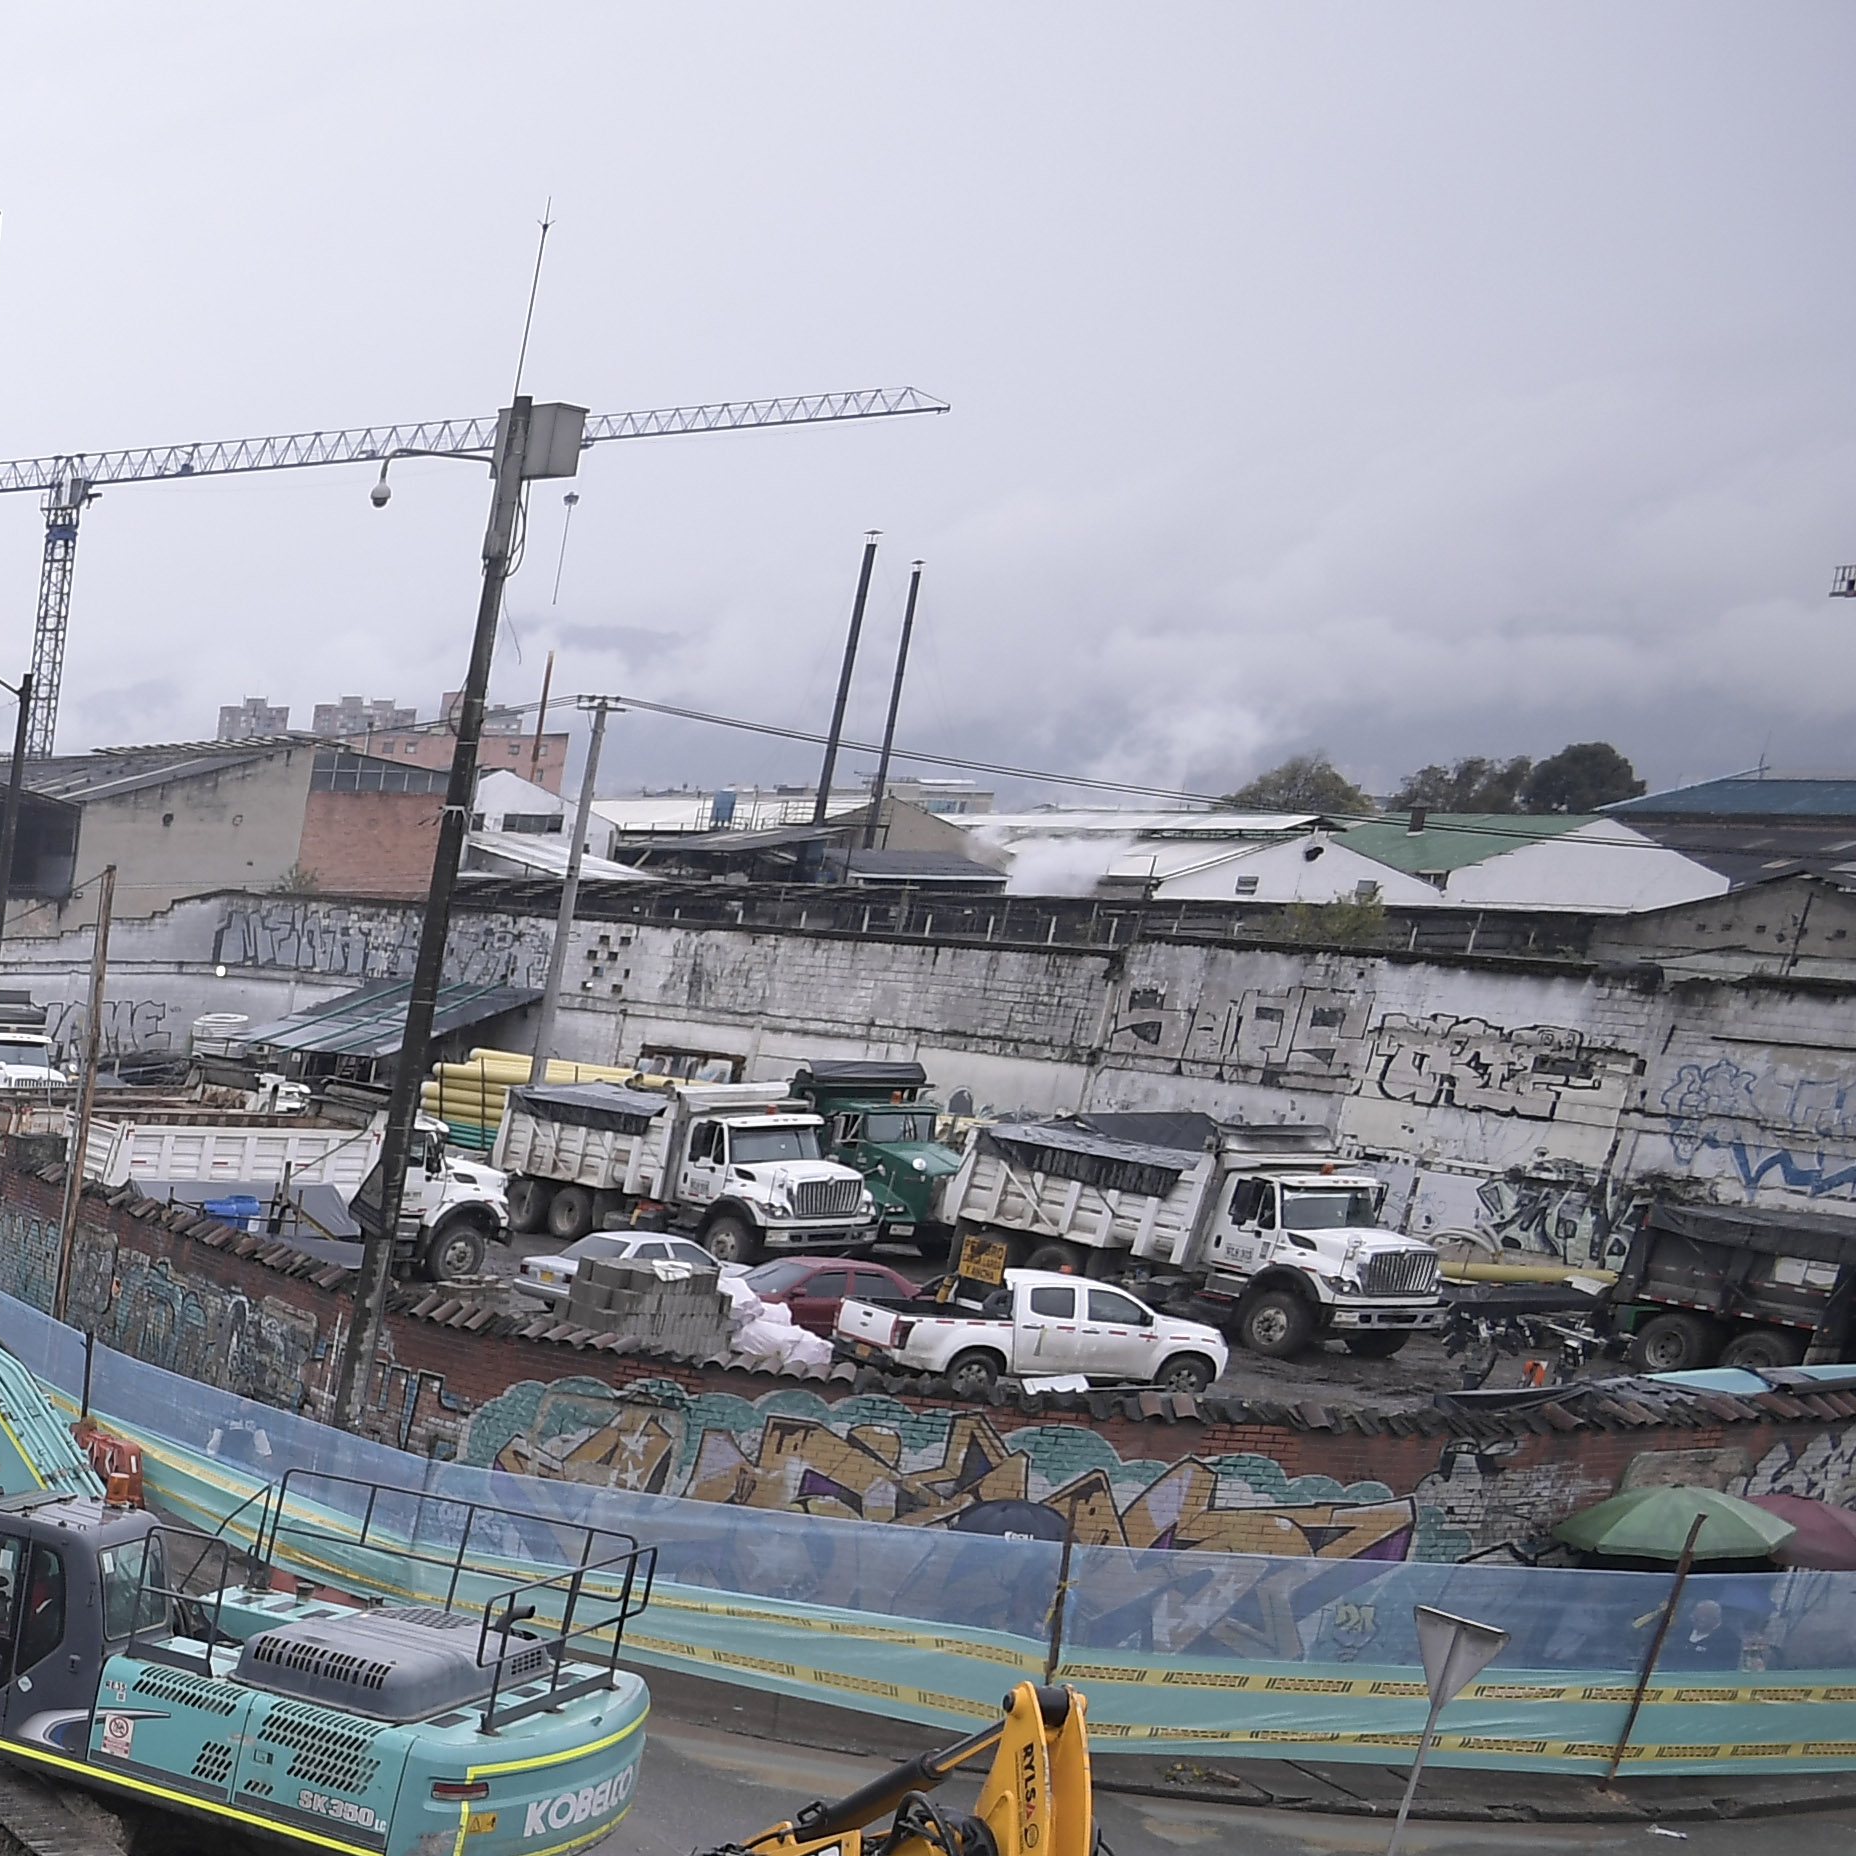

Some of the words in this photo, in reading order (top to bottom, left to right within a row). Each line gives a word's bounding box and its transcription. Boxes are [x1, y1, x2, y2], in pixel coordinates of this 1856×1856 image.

[299, 1790, 376, 1827] SK350
[374, 1818, 387, 1832] LC
[524, 1764, 635, 1838] KOBELCO
